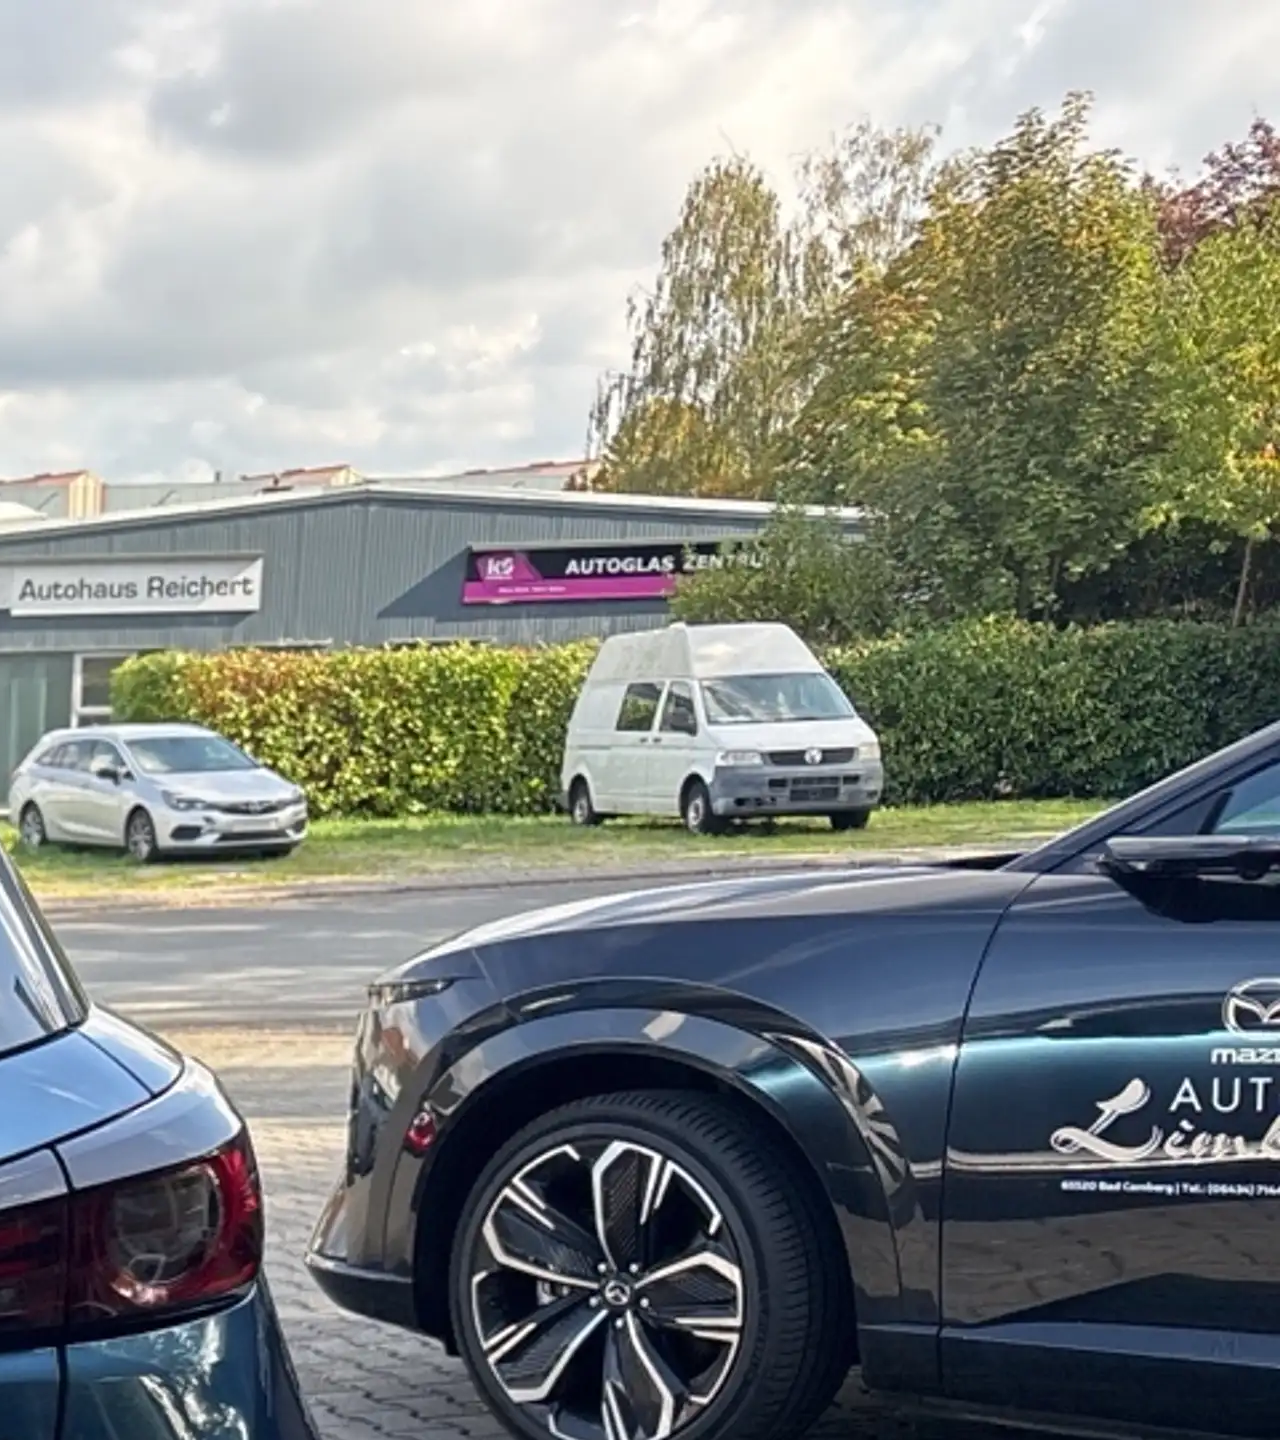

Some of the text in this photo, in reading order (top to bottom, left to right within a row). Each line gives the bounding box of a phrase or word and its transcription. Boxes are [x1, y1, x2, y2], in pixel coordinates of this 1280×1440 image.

[565, 555, 675, 575] AUTOGLAS
[18, 575, 254, 601] Autohaus Reichert
